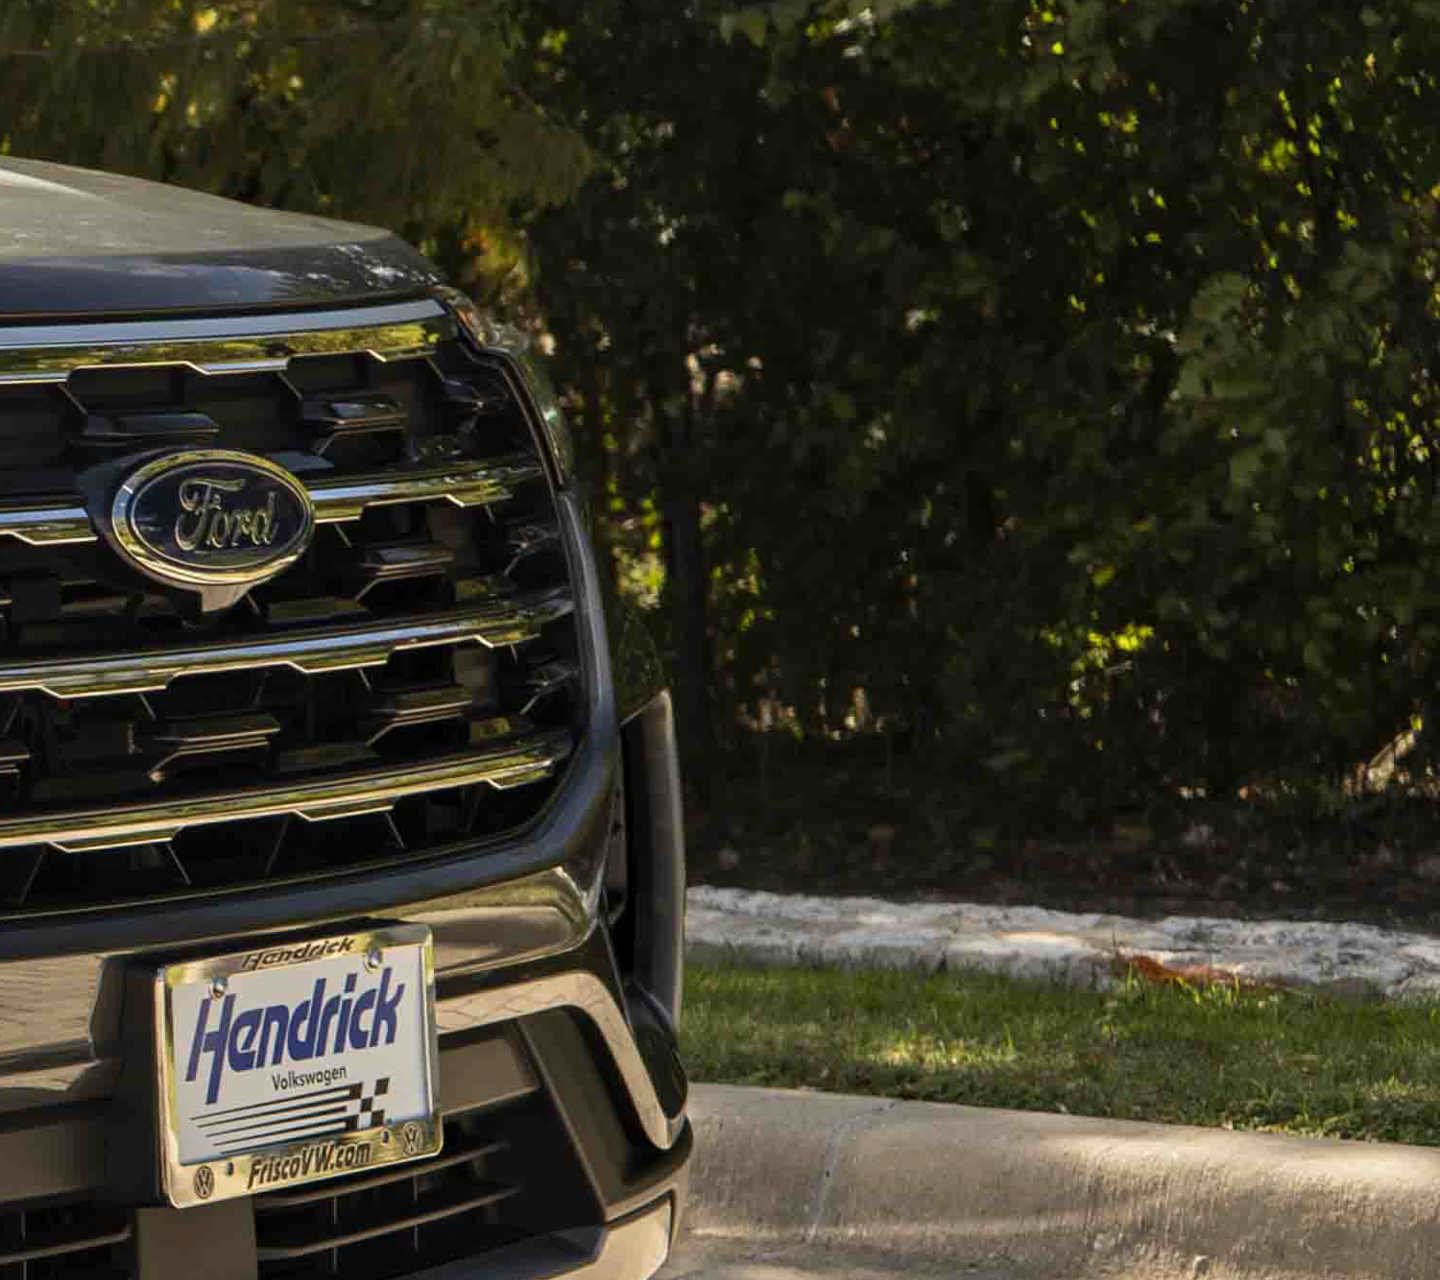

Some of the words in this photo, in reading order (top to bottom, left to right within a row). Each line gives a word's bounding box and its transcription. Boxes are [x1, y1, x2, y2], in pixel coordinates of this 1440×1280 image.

[176, 478, 282, 551] Ford
[242, 937, 354, 970] Hendrick
[185, 967, 405, 1105] Hendrick
[272, 1065, 347, 1091] Volkswagen
[247, 1142, 371, 1190] FriscoVW.com
